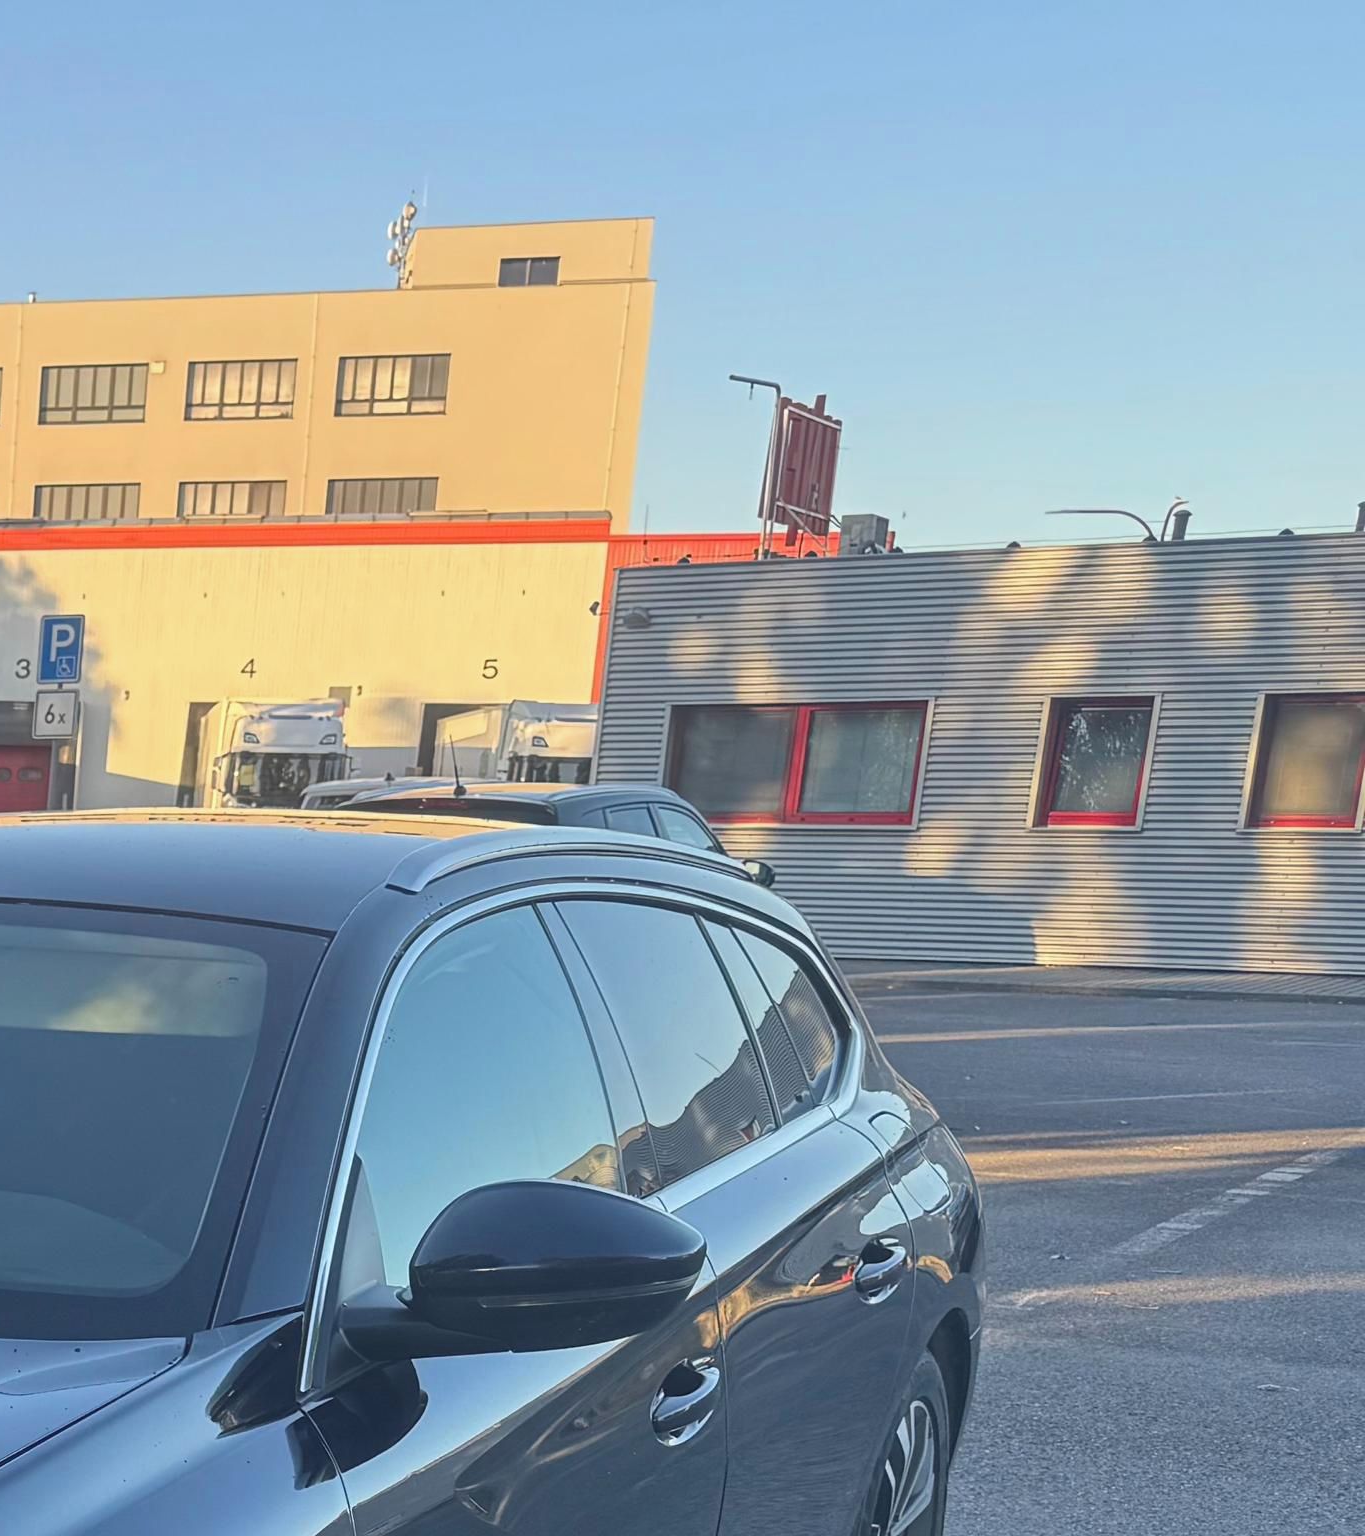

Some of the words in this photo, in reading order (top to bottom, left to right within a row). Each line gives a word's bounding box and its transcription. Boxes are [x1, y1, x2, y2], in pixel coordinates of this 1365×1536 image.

[49, 623, 75, 662] P
[15, 658, 31, 679] 3
[241, 658, 257, 679] 4
[482, 659, 499, 680] 5
